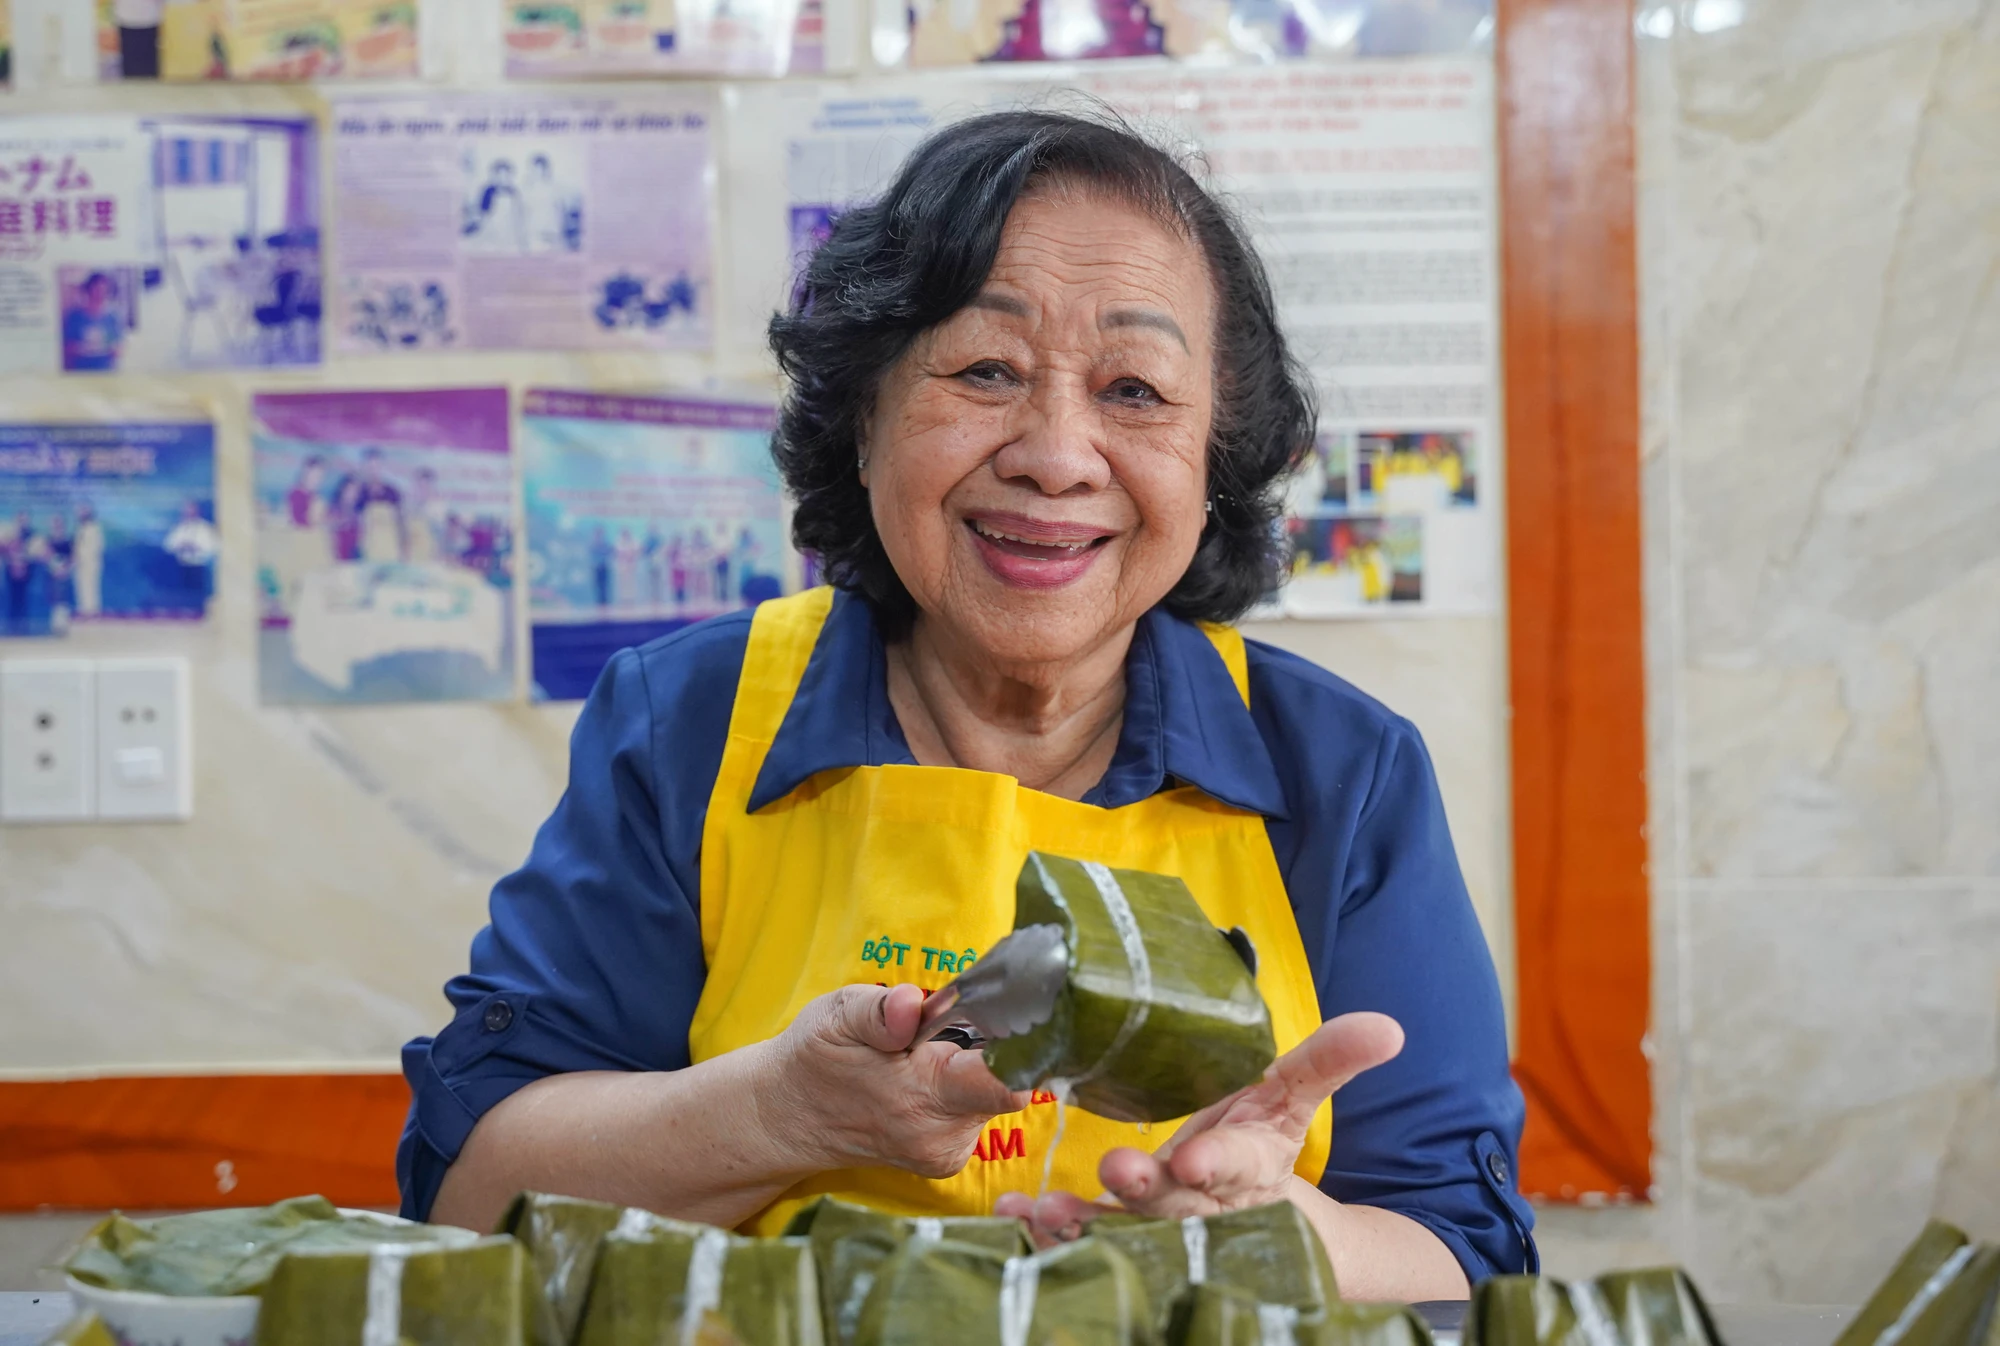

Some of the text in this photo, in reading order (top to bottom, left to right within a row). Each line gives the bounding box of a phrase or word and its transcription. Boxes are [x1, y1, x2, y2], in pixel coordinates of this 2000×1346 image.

[861, 935, 977, 973] BỘT TRÔ
[972, 1128, 1026, 1161] AM
